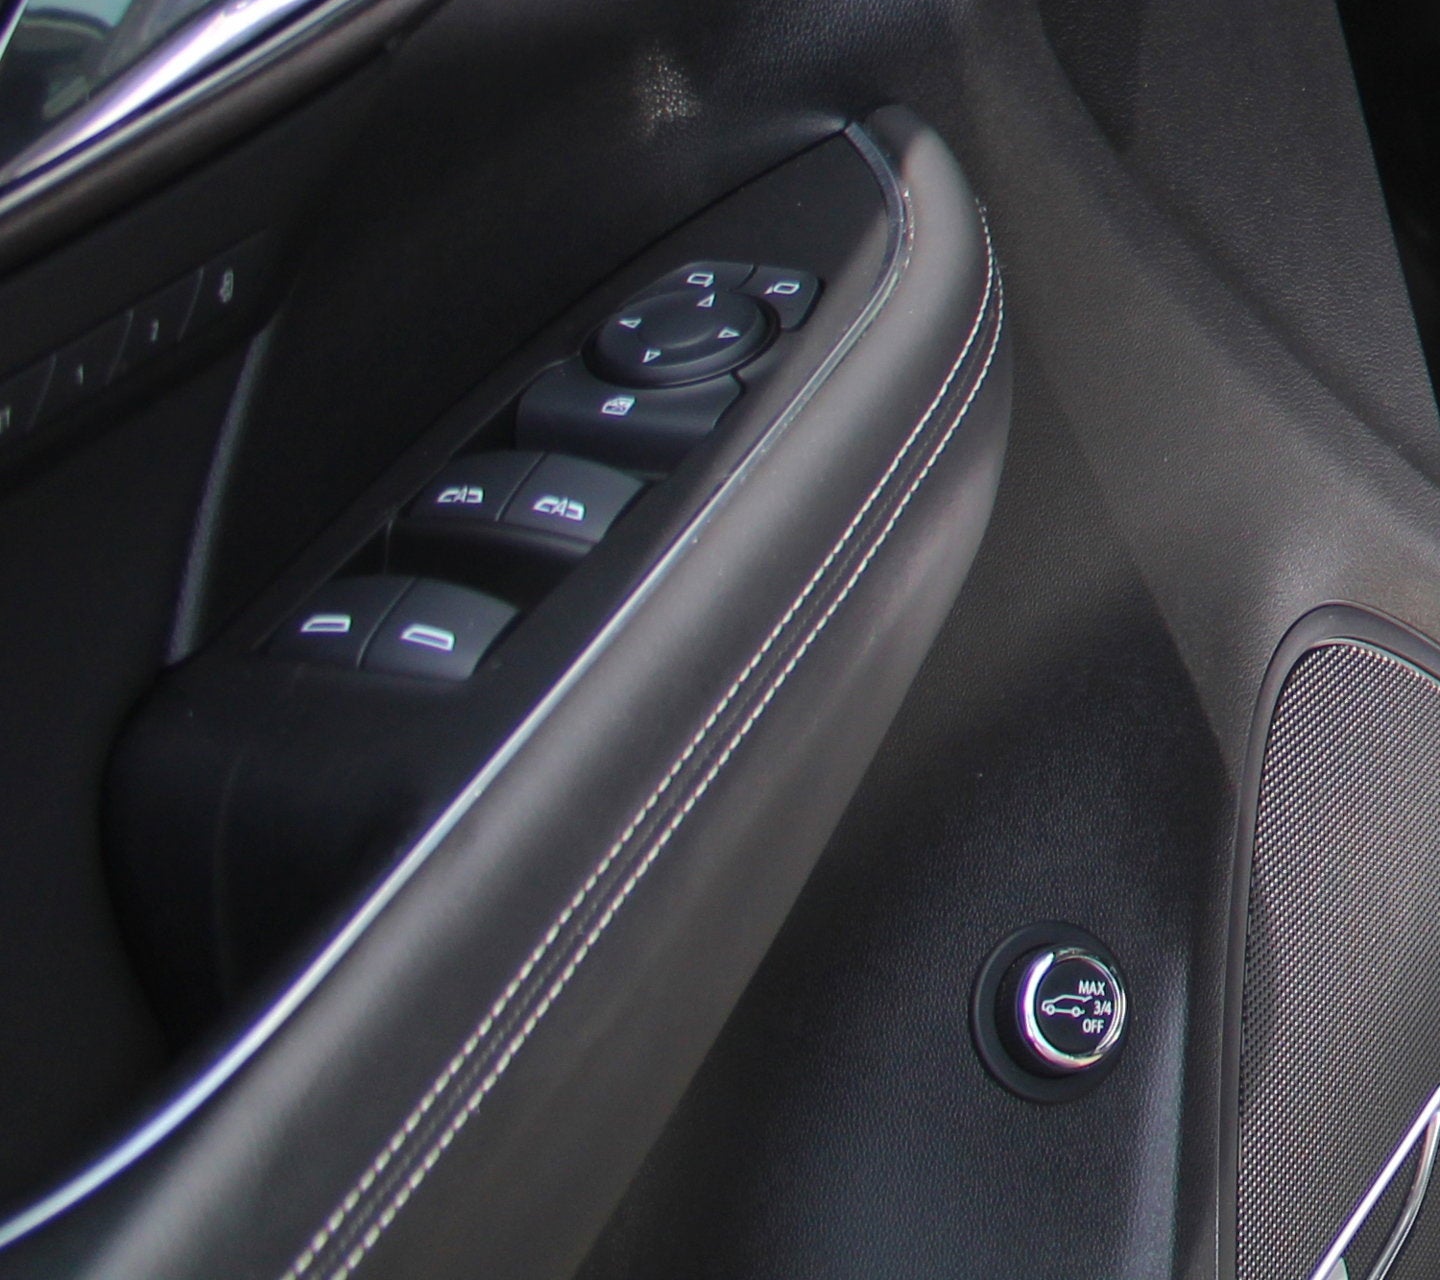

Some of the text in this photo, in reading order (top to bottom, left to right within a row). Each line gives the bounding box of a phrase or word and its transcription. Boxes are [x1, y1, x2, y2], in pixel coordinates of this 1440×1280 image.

[1078, 979, 1106, 996] MAX
[1093, 999, 1113, 1016] 3/4
[1082, 1018, 1105, 1034] OFF
